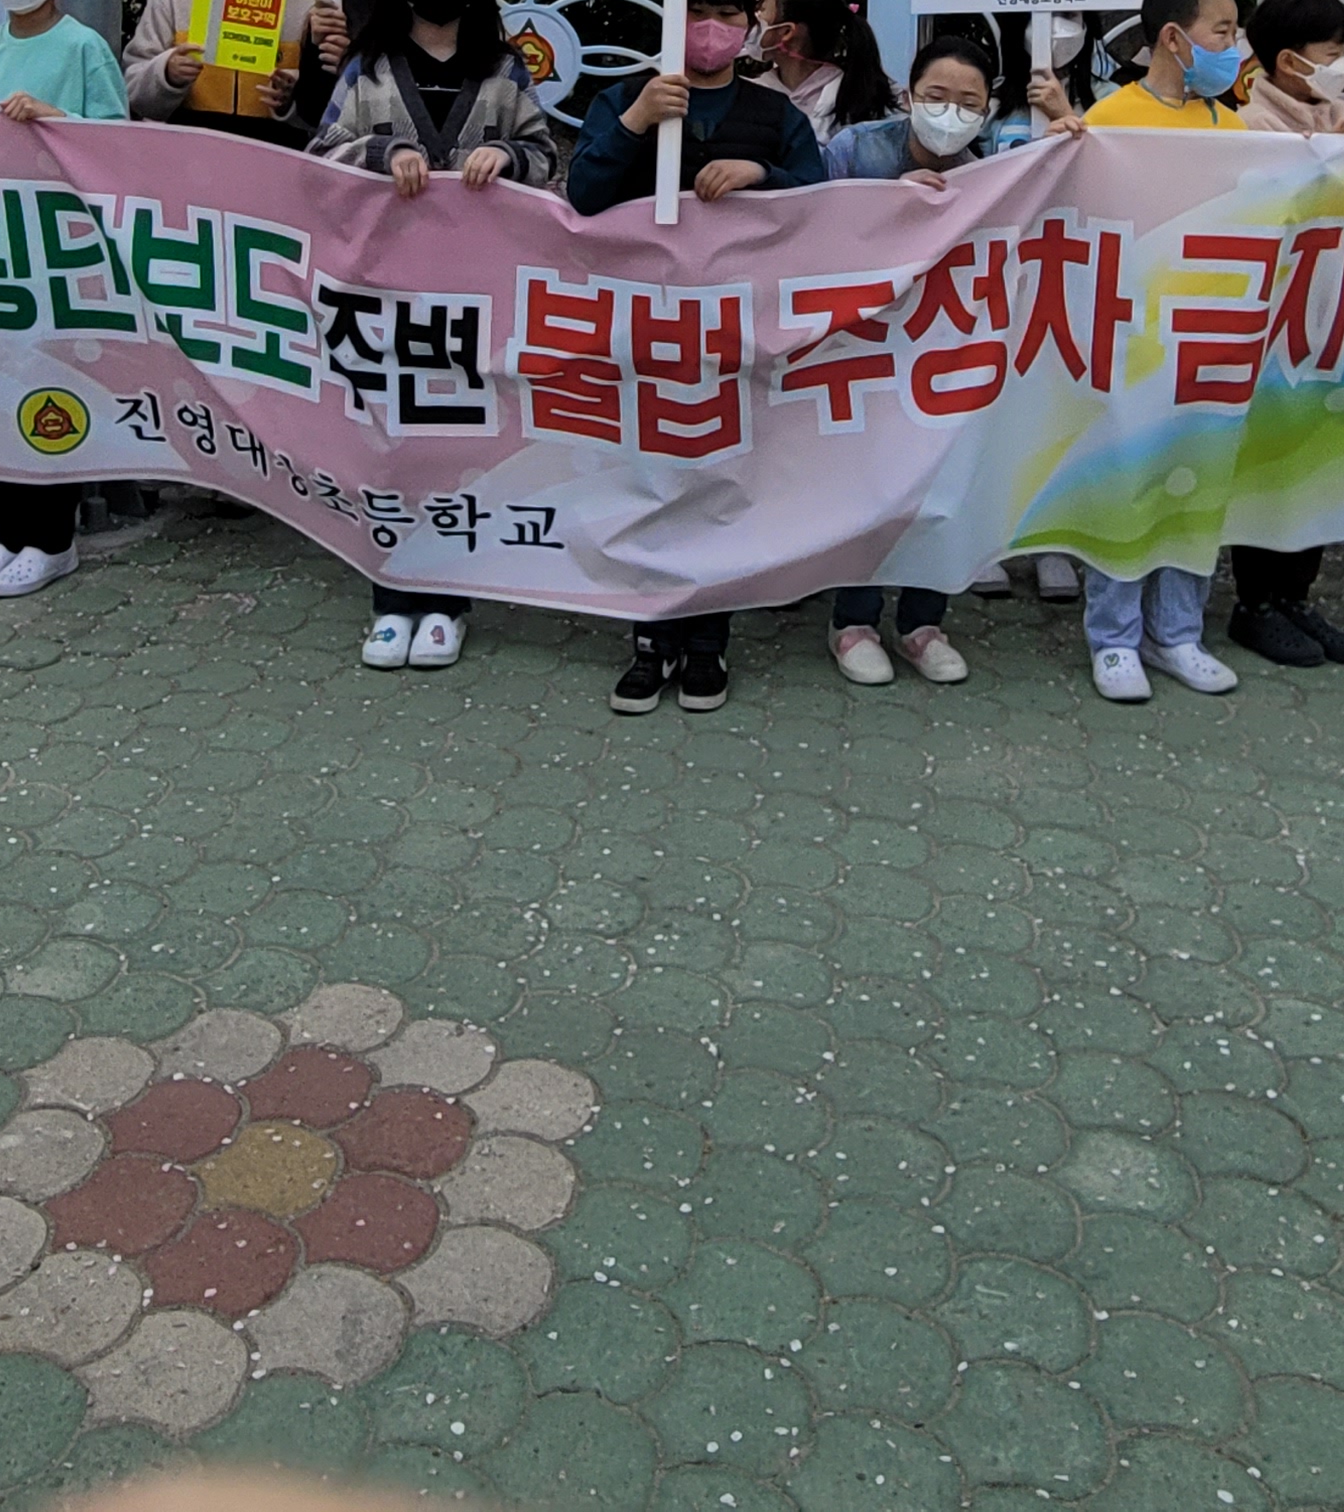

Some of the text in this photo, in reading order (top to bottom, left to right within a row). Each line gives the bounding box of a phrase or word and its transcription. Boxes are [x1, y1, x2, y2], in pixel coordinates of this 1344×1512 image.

[316, 283, 487, 426] 주변
[517, 278, 743, 459] 불법
[780, 216, 1134, 423] 주정차
